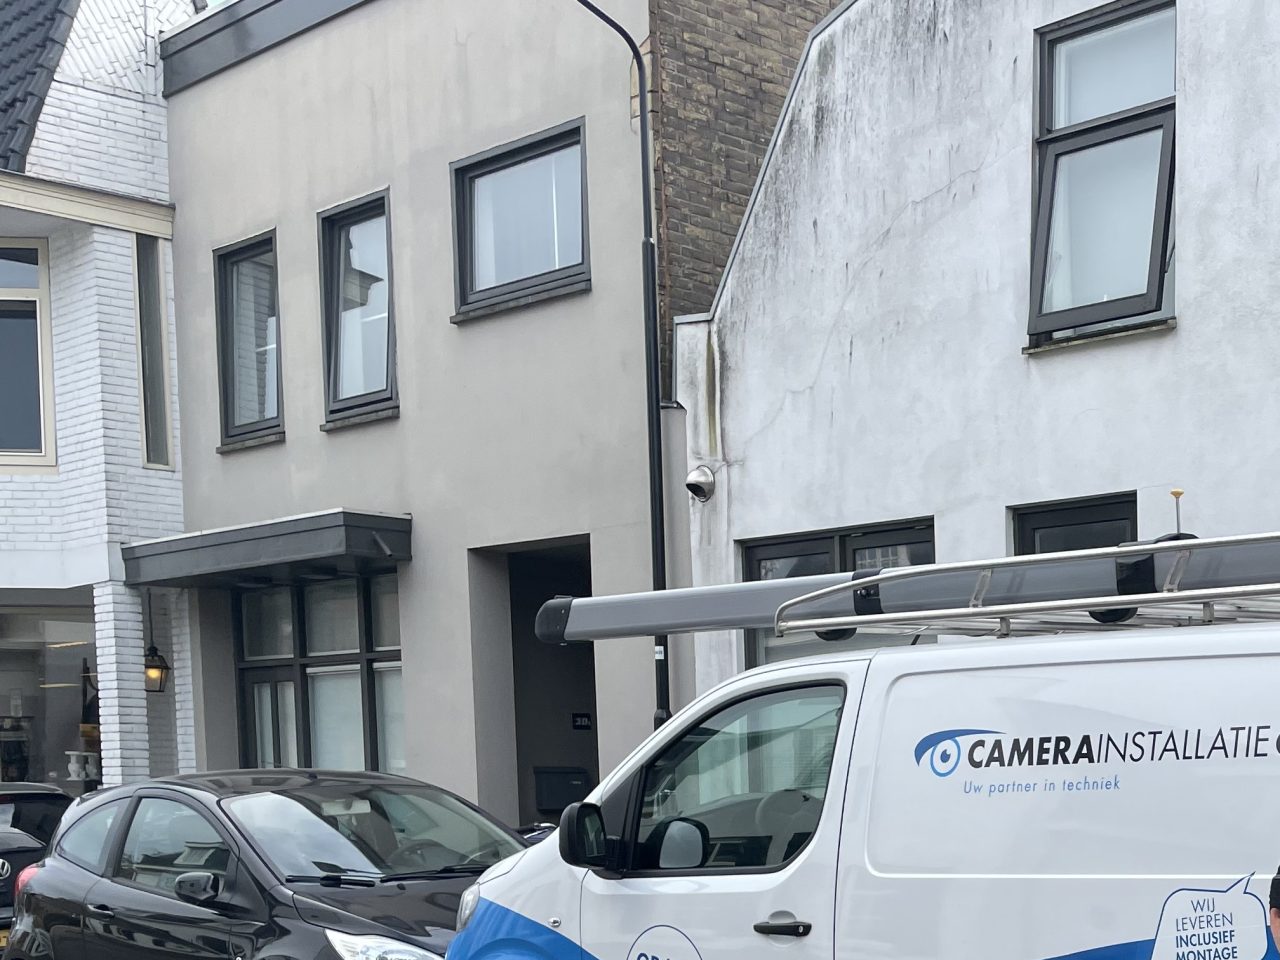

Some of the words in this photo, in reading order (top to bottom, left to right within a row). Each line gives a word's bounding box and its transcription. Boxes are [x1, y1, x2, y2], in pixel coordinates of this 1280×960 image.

[967, 725, 1272, 769] CAMERAINSTALLATIE
[963, 779, 984, 794] Uw
[988, 779, 1038, 797] partner
[1044, 778, 1056, 791] in
[1062, 774, 1121, 792] techniek
[1190, 897, 1216, 913] WIJ
[1175, 912, 1234, 932] LEVEREN
[1175, 930, 1235, 949] INCLUSIEF
